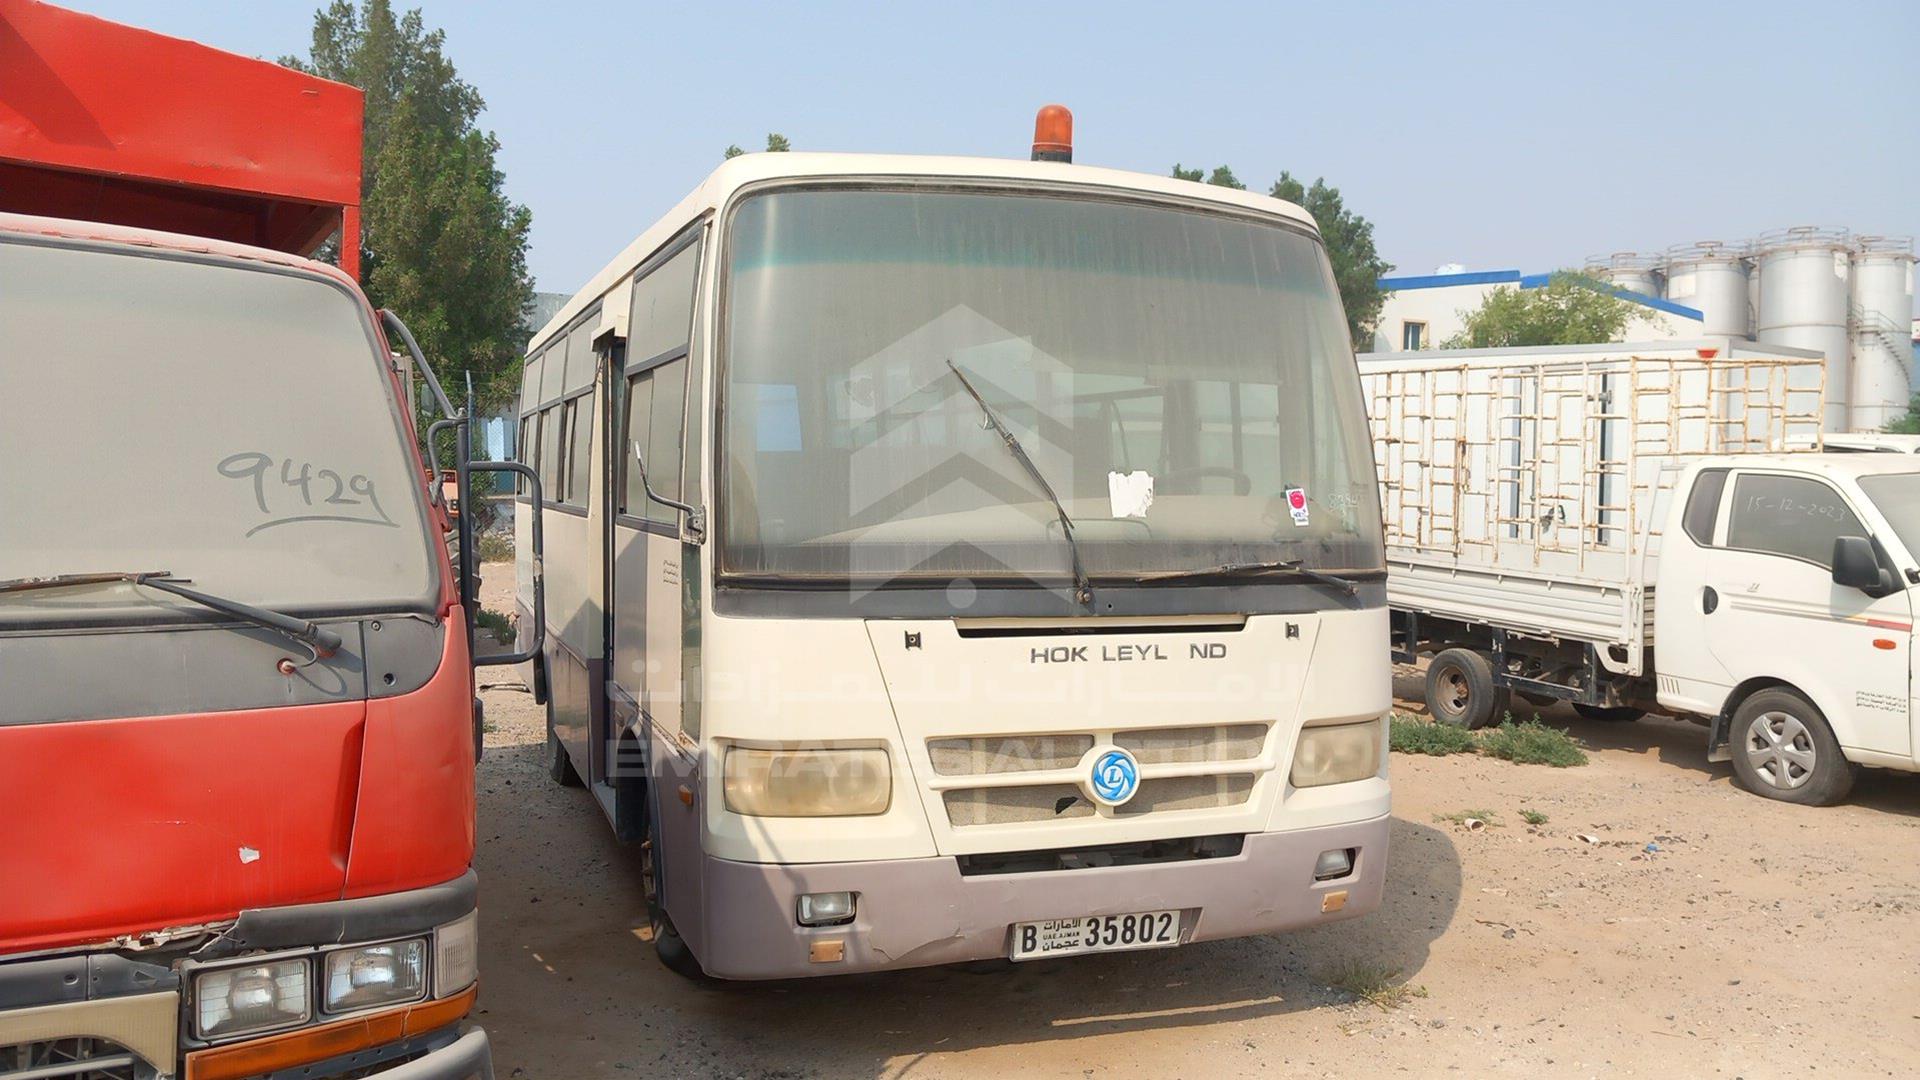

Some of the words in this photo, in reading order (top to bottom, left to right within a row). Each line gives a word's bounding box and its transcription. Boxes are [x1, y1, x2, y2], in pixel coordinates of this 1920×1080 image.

[217, 452, 397, 526] 9429
[1030, 646, 1088, 663] HOK
[1022, 925, 1037, 953] B
[1085, 913, 1172, 947] 35802
[1042, 939, 1080, 951] عجمان
